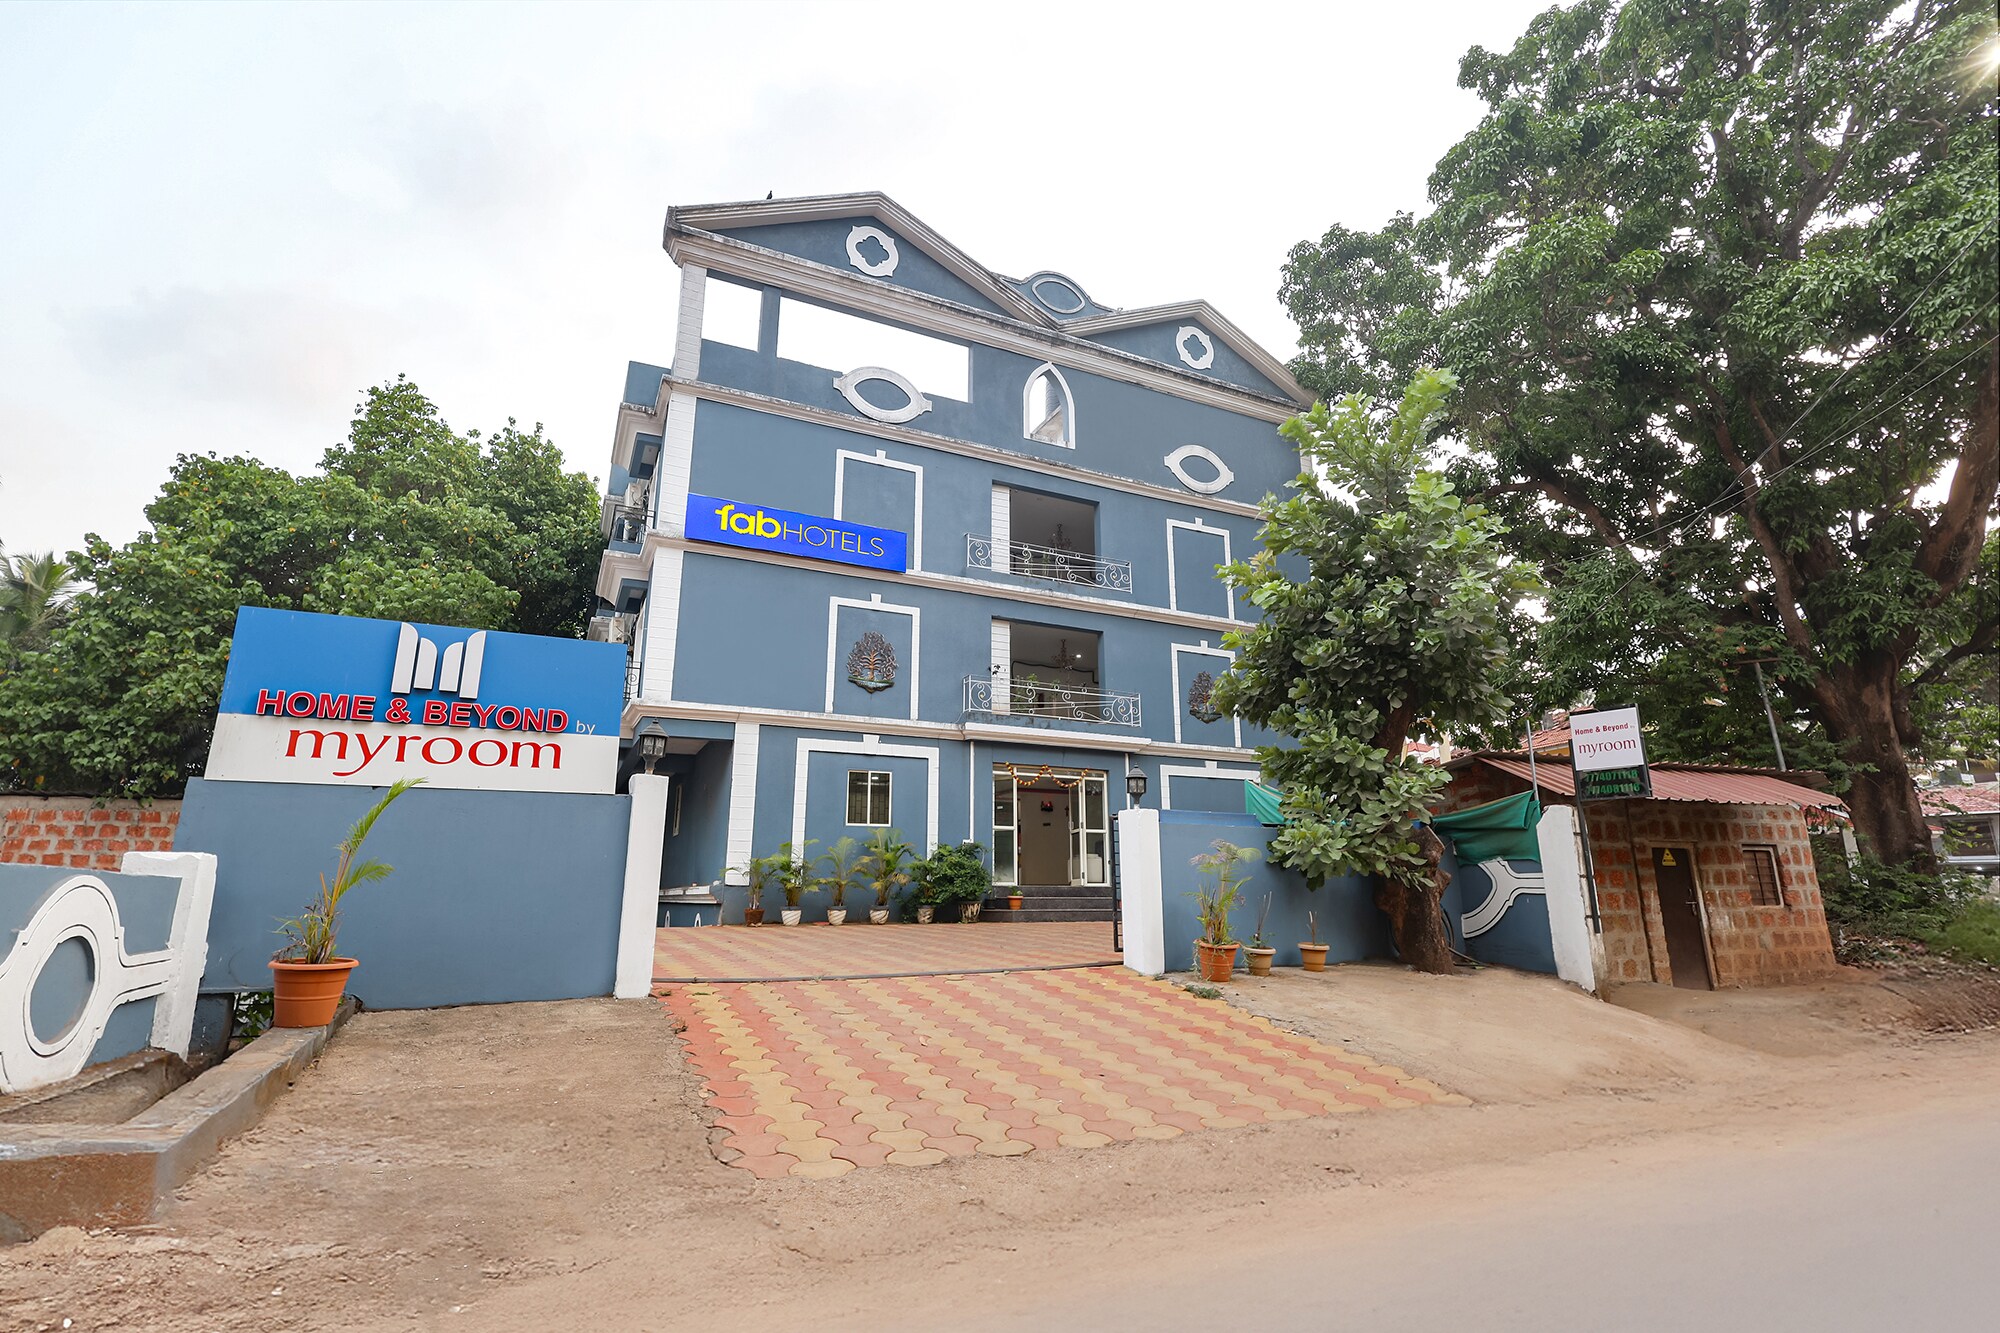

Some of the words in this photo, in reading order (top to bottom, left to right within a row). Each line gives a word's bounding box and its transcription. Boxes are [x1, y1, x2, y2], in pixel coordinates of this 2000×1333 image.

[255, 688, 377, 722] HOME
[384, 697, 412, 725] &
[422, 699, 569, 733] BEYOND
[575, 719, 596, 736] by
[1602, 723, 1628, 732] Beyond
[284, 728, 562, 777] myroom
[1578, 738, 1637, 758] myroom
